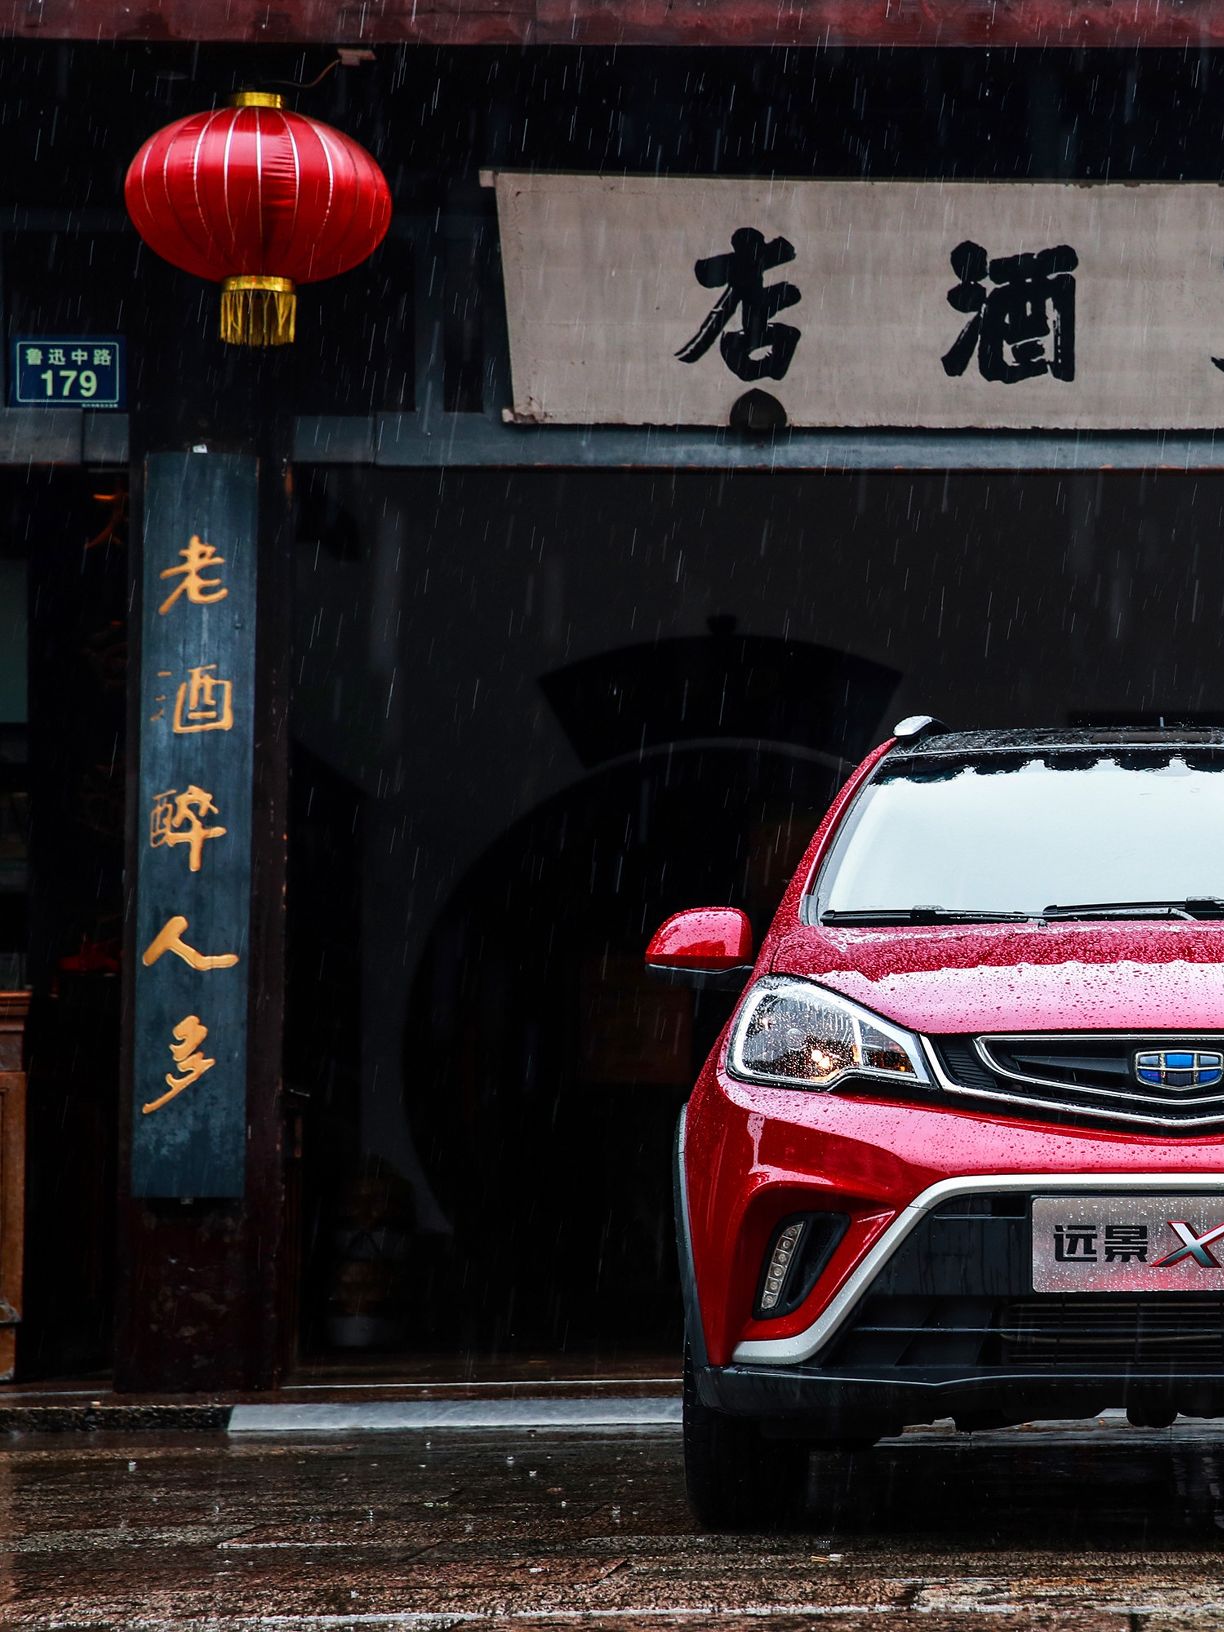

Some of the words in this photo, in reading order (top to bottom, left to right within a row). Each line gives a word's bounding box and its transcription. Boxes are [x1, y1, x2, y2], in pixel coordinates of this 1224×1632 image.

[25, 348, 112, 366] 鲁迅中路
[41, 369, 98, 398] 179
[141, 534, 240, 1114] 老酒醉人多
[1052, 1225, 1149, 1263] 远景
